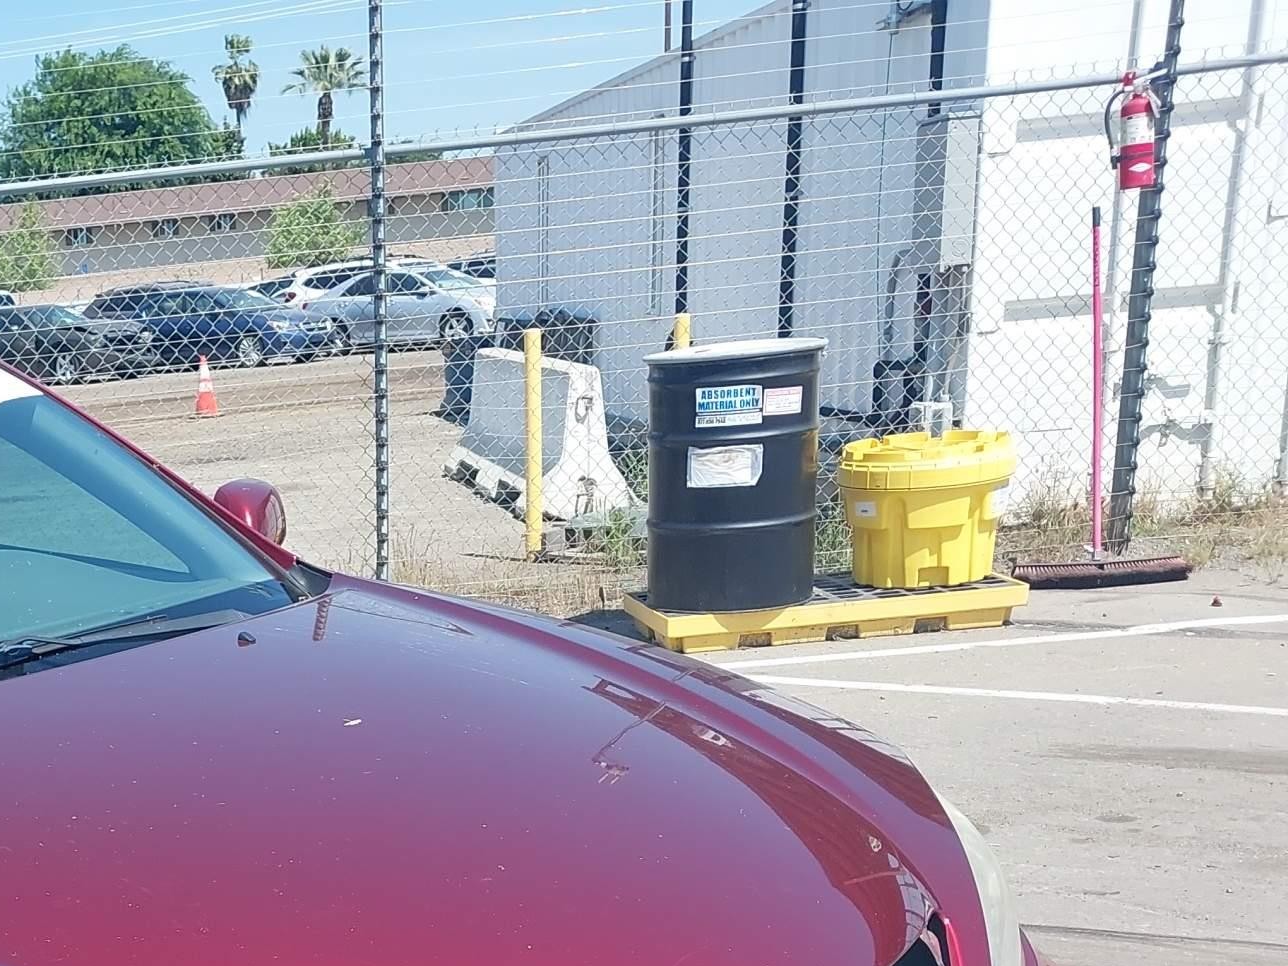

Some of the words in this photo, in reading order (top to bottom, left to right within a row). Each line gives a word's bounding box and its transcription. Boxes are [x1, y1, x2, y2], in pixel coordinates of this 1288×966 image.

[701, 387, 756, 400] ABSORBENT
[698, 400, 737, 411] MATERIAL
[740, 397, 760, 408] ONLY
